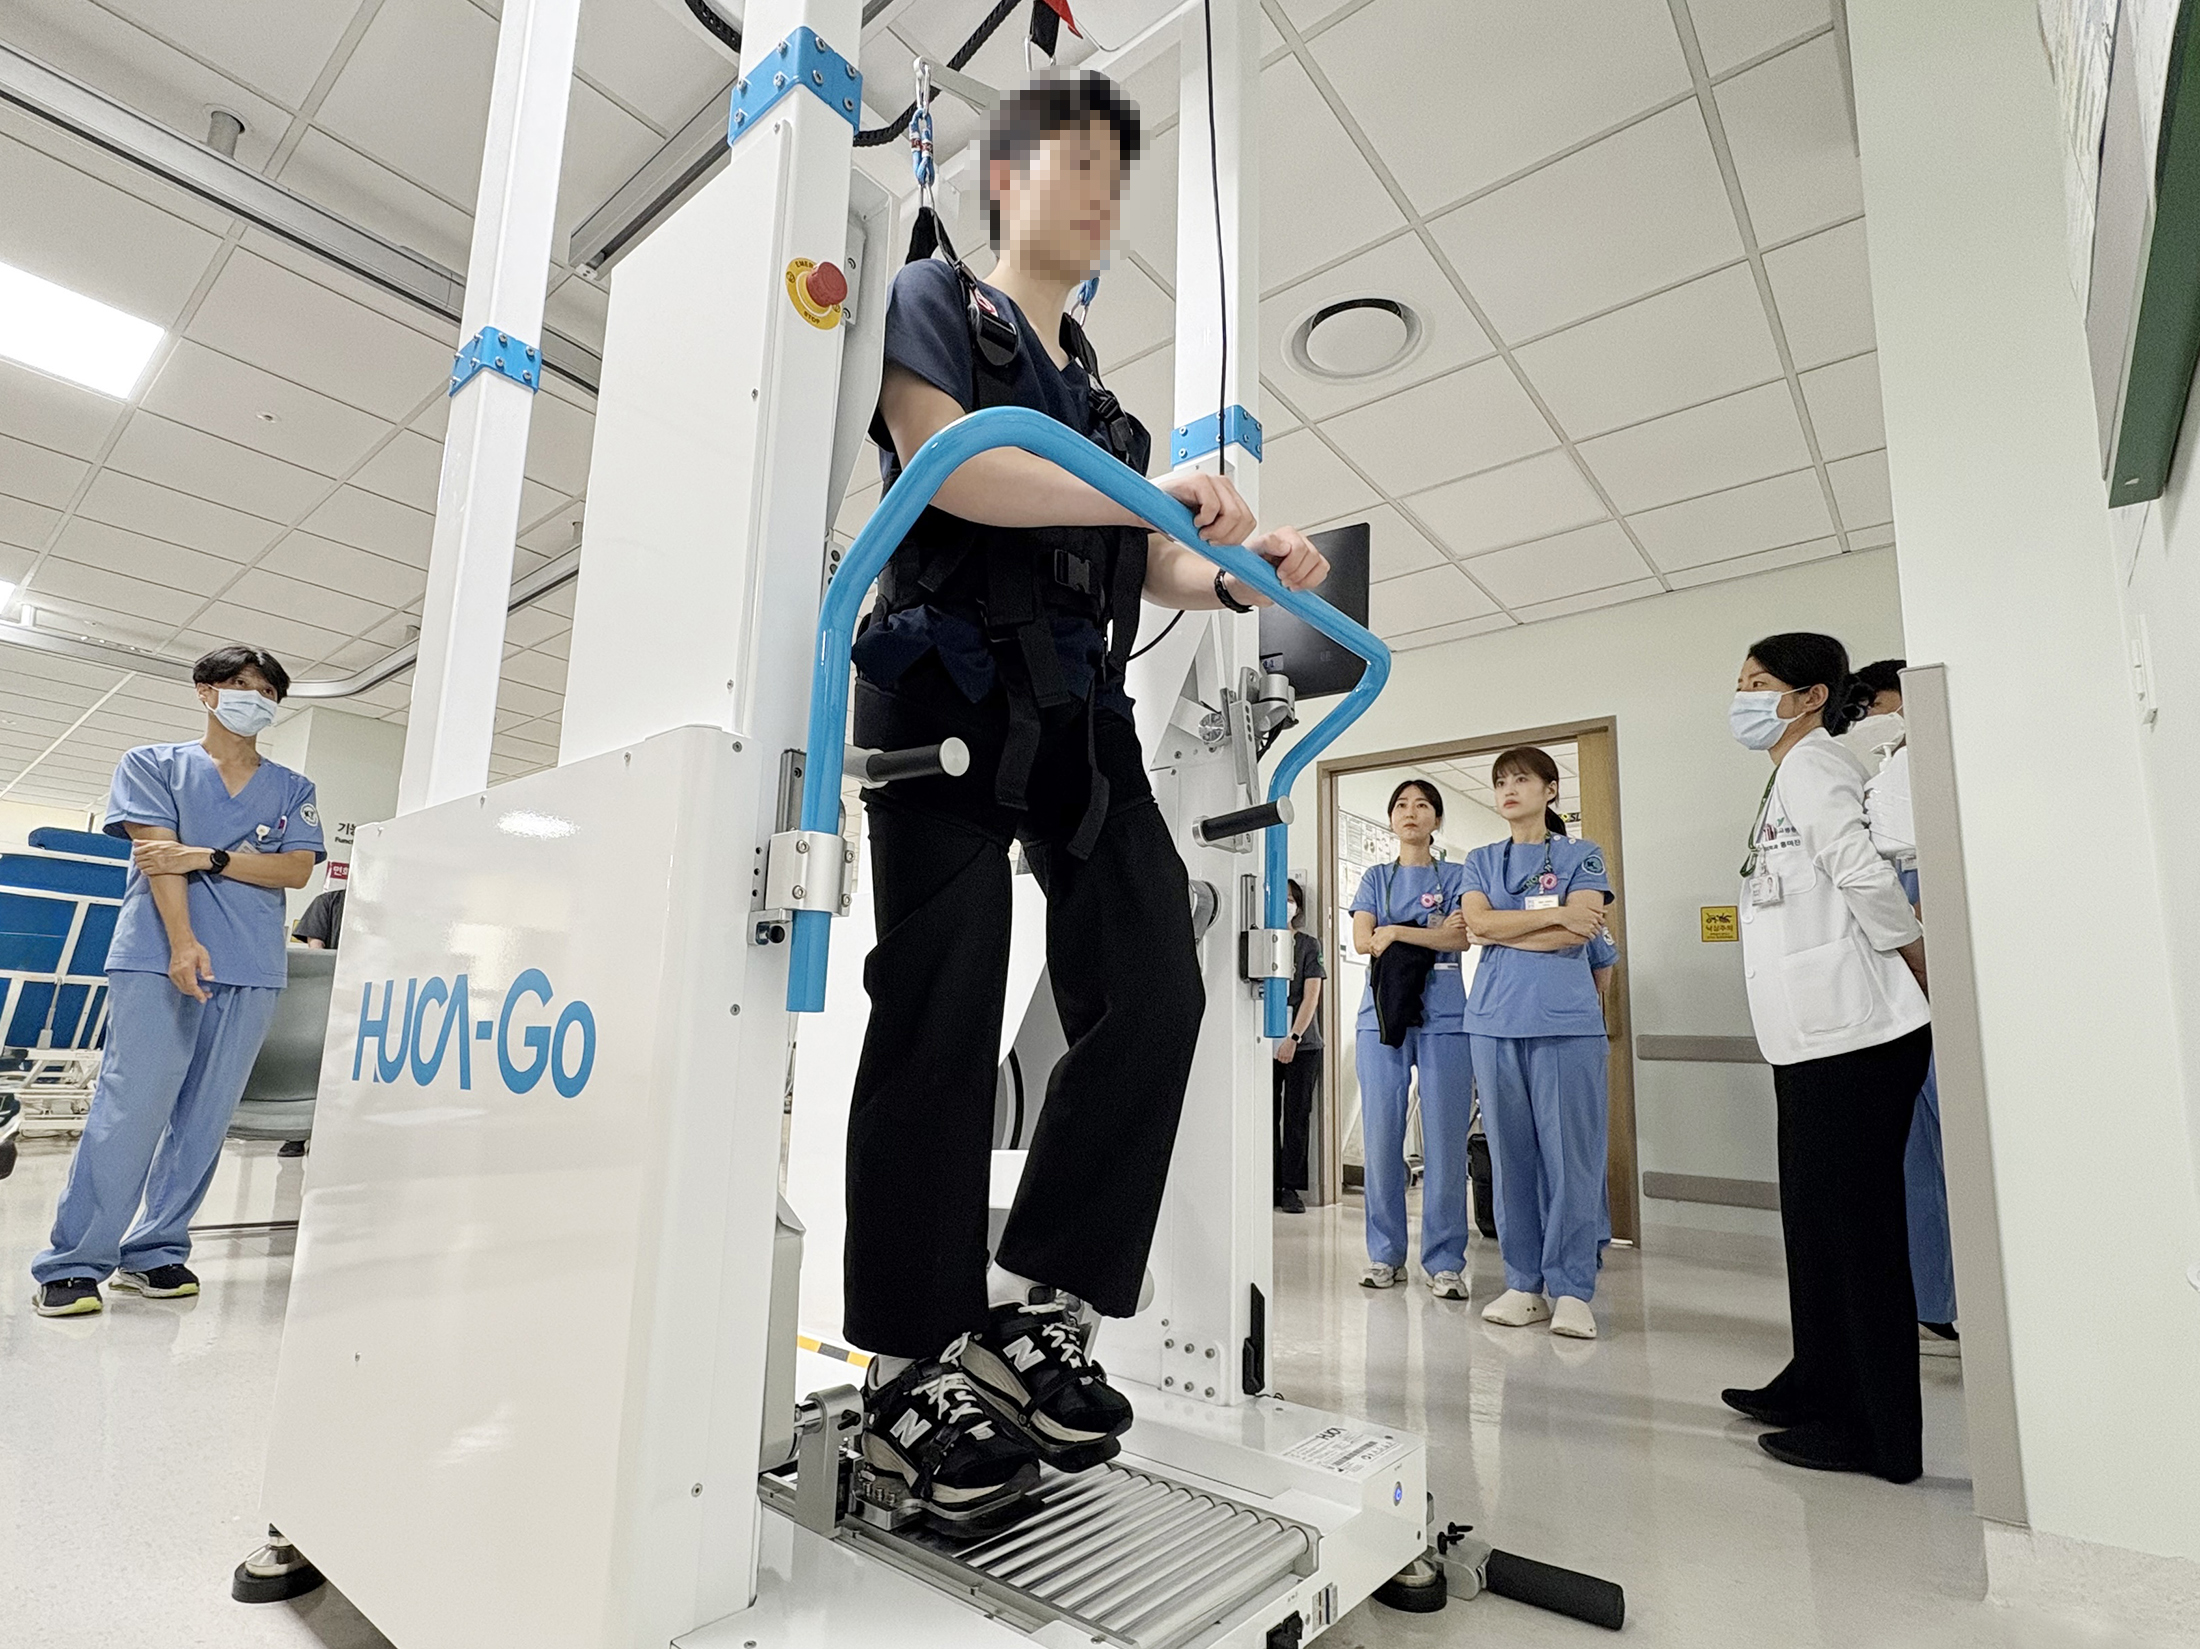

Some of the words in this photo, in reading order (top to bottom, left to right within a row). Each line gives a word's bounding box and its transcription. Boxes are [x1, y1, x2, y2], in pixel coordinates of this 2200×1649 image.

[803, 310, 821, 325] STOP
[1002, 1335, 1047, 1373] N
[889, 1407, 933, 1450] N
